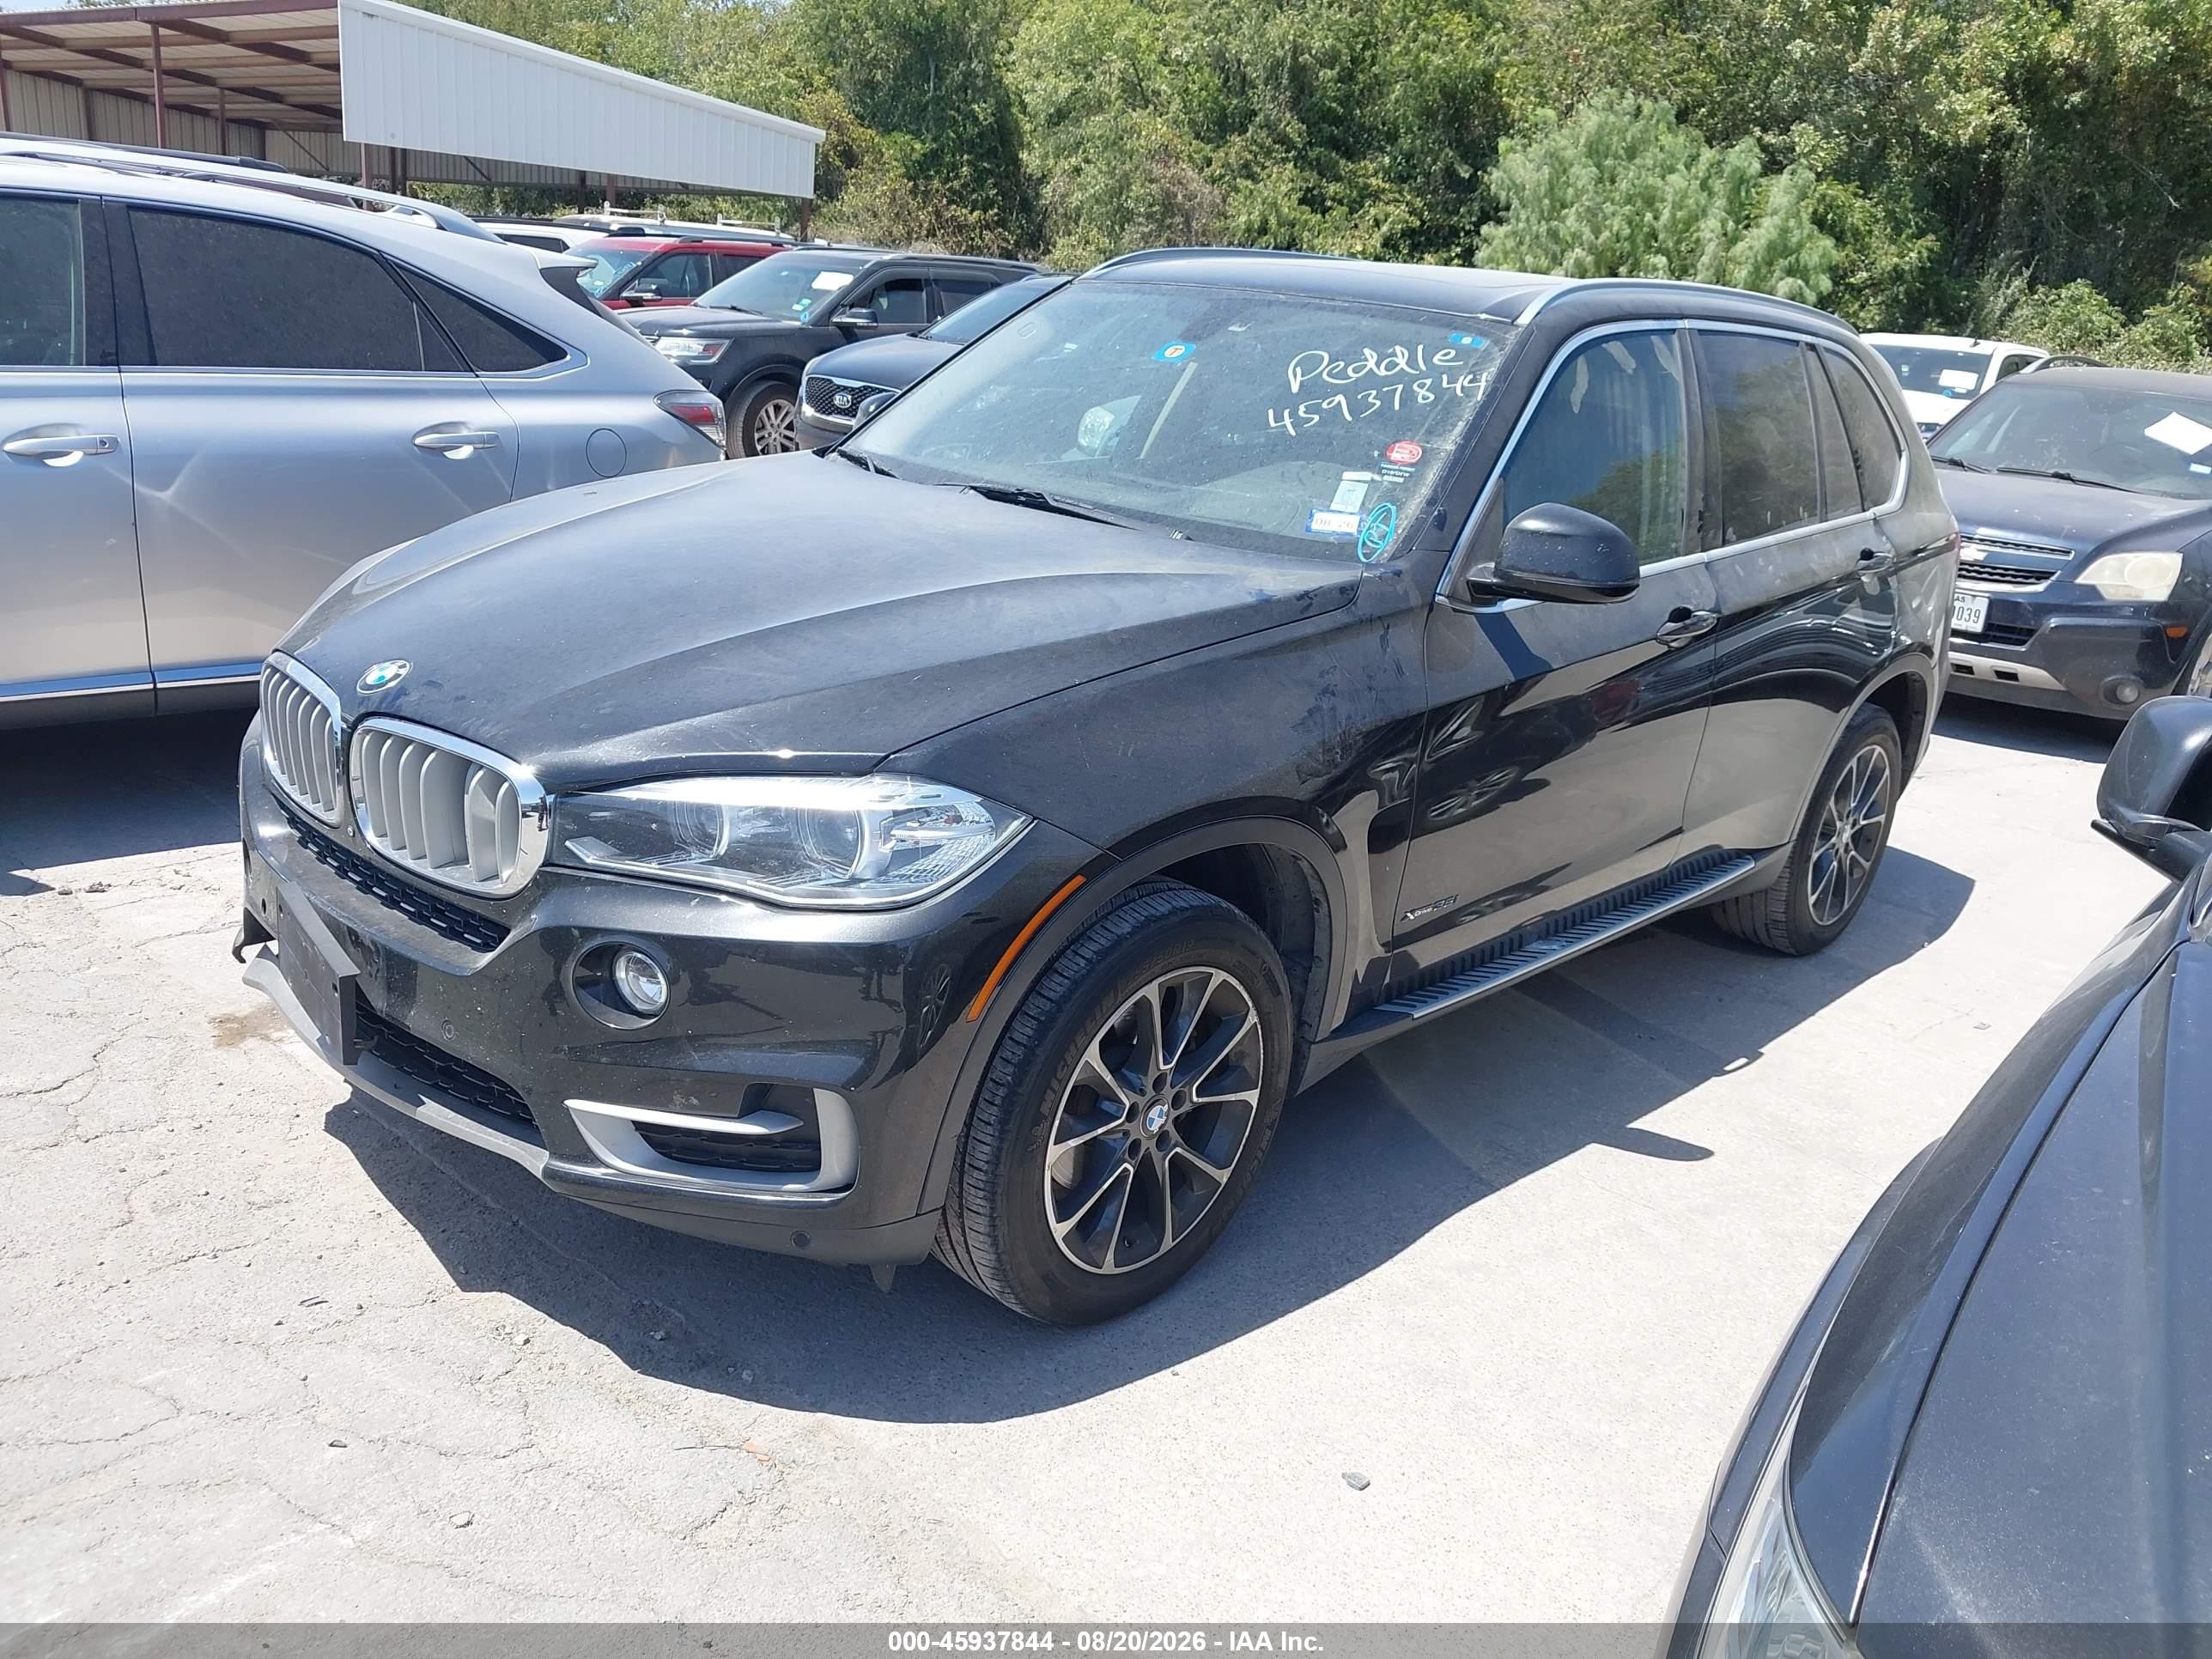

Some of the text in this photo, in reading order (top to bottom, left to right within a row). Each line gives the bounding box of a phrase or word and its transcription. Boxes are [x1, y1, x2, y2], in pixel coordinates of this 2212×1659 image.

[1288, 344, 1463, 393] Peddle
[834, 393, 850, 407] KIA
[1267, 371, 1488, 436] 45937844
[1952, 605, 1980, 623] 039
[1039, 985, 1120, 1116] MICHELIN
